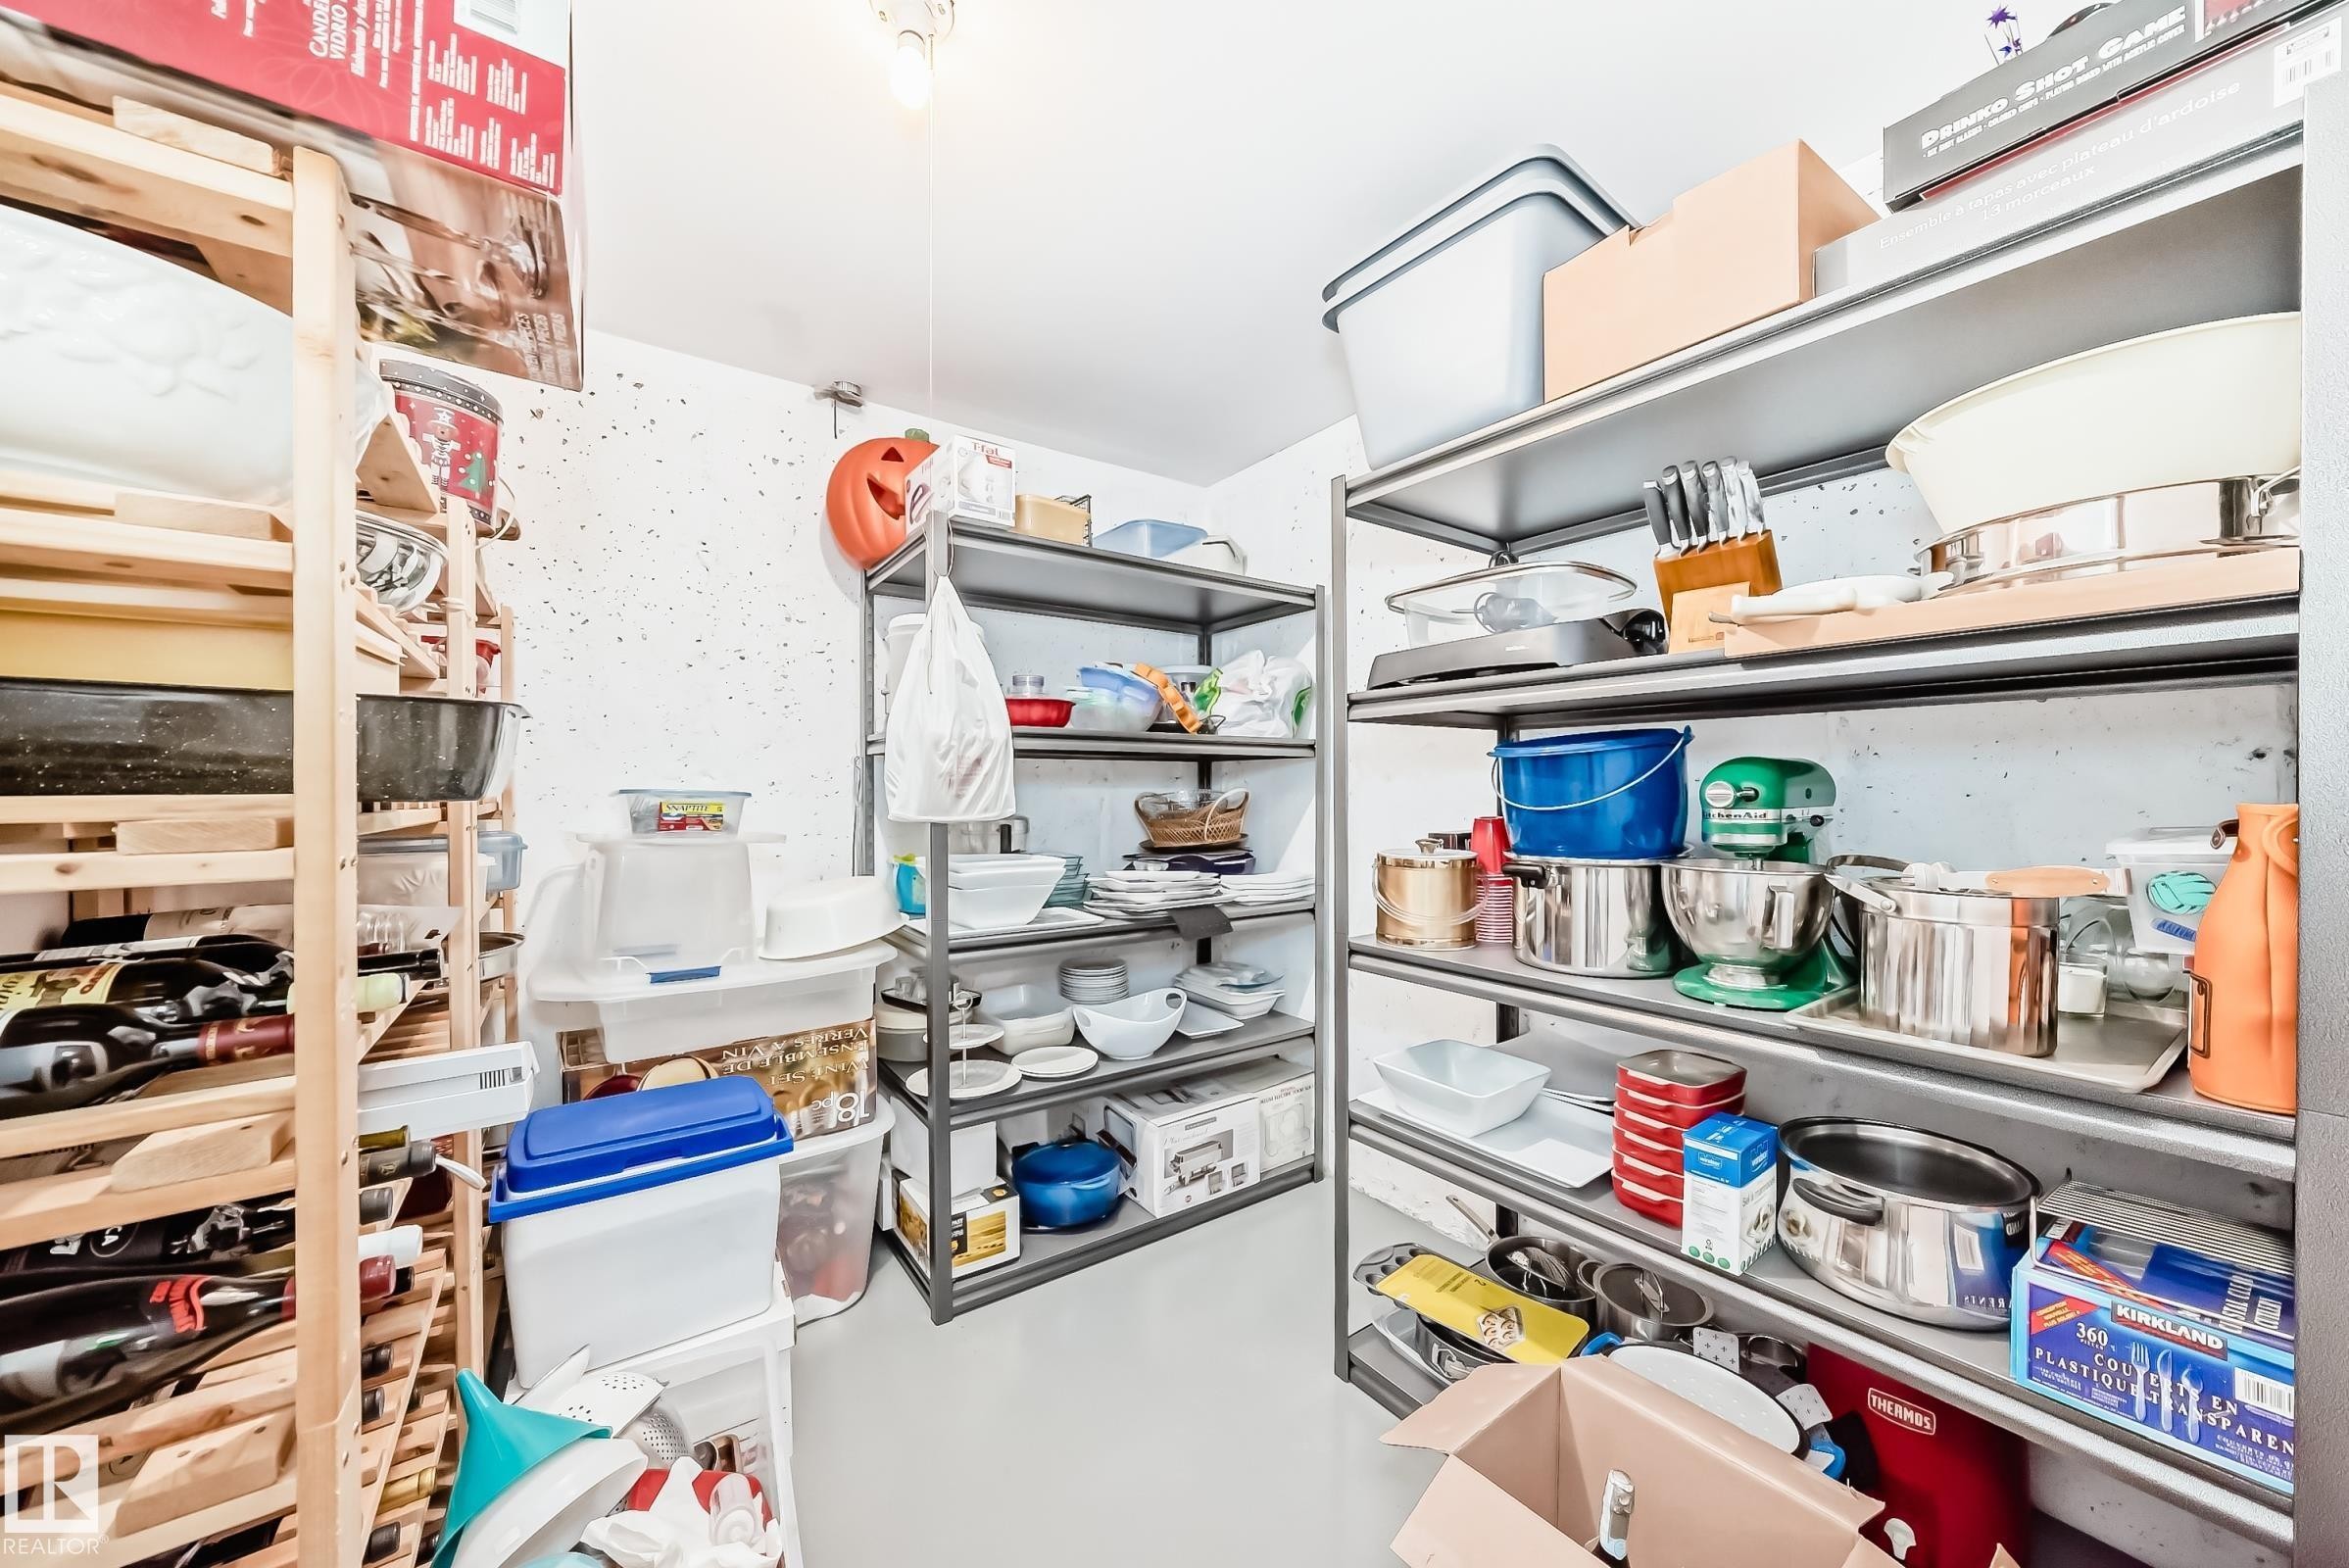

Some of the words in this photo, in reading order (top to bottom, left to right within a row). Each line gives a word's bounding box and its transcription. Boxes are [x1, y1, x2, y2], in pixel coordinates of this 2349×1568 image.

[329, 4, 348, 59] VIDRIO
[1921, 97, 2009, 150] DRINKO
[2014, 55, 2089, 102] SHOT
[2098, 5, 2186, 60] GAME
[2102, 56, 2123, 72] WITH
[1880, 210, 1952, 249] Ensemble
[1954, 202, 1966, 218] à
[1968, 186, 2013, 213] tapas
[2014, 163, 2058, 189] avec
[2062, 130, 2135, 172] plateau
[2139, 81, 2241, 134] d'ardoise
[1982, 206, 2001, 221] 13
[2005, 166, 2096, 210] morceaux
[721, 1046, 764, 1060] VIN
[794, 1027, 869, 1048] VERRES
[722, 1060, 752, 1075] DE
[759, 1040, 870, 1068] ENSEMBLE
[811, 1058, 870, 1079] WINE
[770, 1070, 806, 1086] SET
[2077, 1322, 2109, 1348] 360
[2117, 1304, 2224, 1350] KIRKLAND
[2094, 1352, 2201, 1402] COUERTS
[2212, 1395, 2238, 1416] EN
[1871, 1395, 1932, 1431] THERMOS
[2035, 1347, 2138, 1397] PLASTIQUE
[2148, 1390, 2294, 1456] TRANSPAREN
